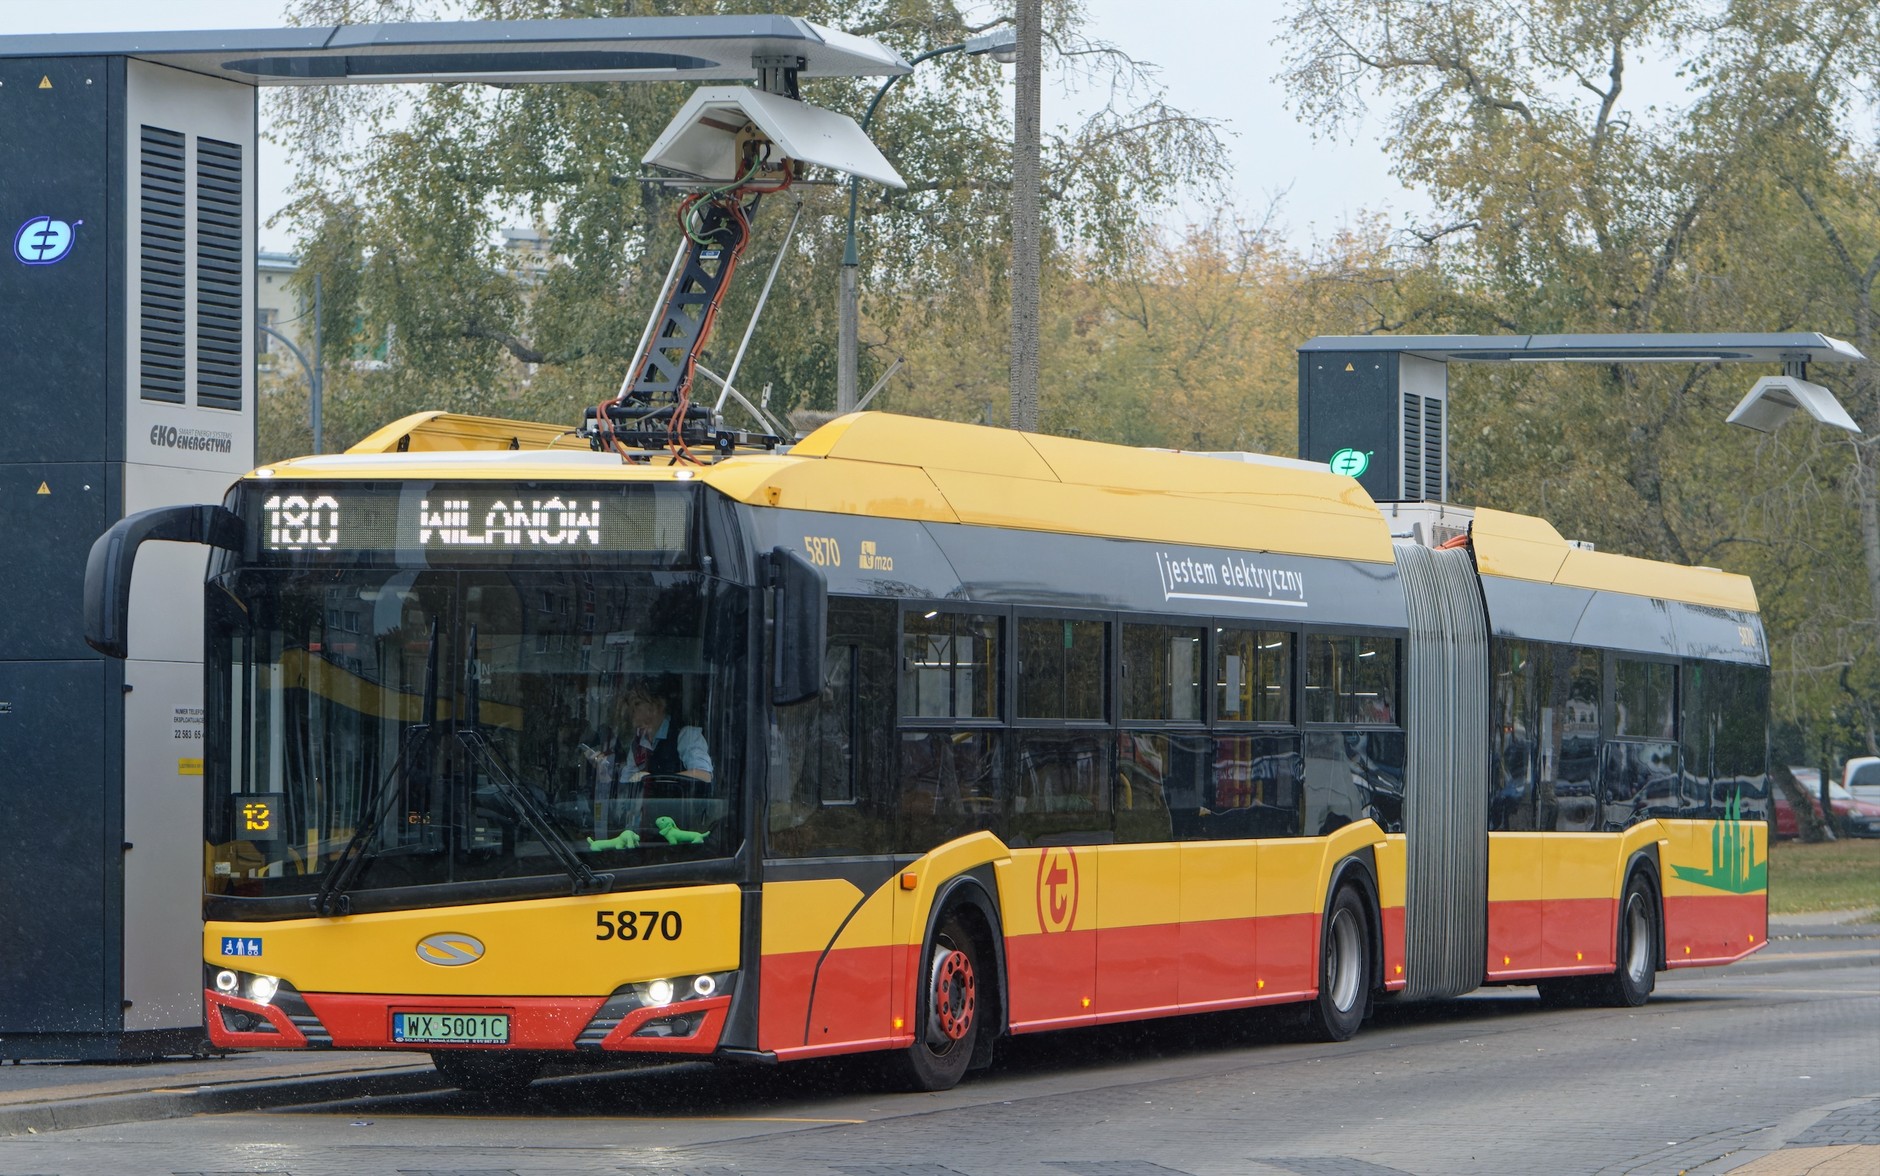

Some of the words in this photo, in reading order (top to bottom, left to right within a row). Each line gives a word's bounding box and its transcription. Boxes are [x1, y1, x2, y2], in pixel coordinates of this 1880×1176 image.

[150, 424, 178, 448] EKO
[177, 435, 232, 453] ENERGETYKA
[178, 428, 194, 436] SMART
[195, 429, 212, 438] ENERGY
[212, 431, 232, 440] SYSTEMS
[264, 495, 339, 550] 180
[420, 496, 599, 544] WILANÓW
[804, 536, 841, 567] 5870
[874, 556, 893, 571] mza
[1164, 552, 1218, 590] jestem
[1221, 557, 1304, 599] elektryczny
[175, 730, 181, 738] 22
[243, 804, 269, 830] 13
[596, 910, 682, 941] 5870
[408, 1016, 432, 1036] WX
[441, 1017, 502, 1037] 5001C
